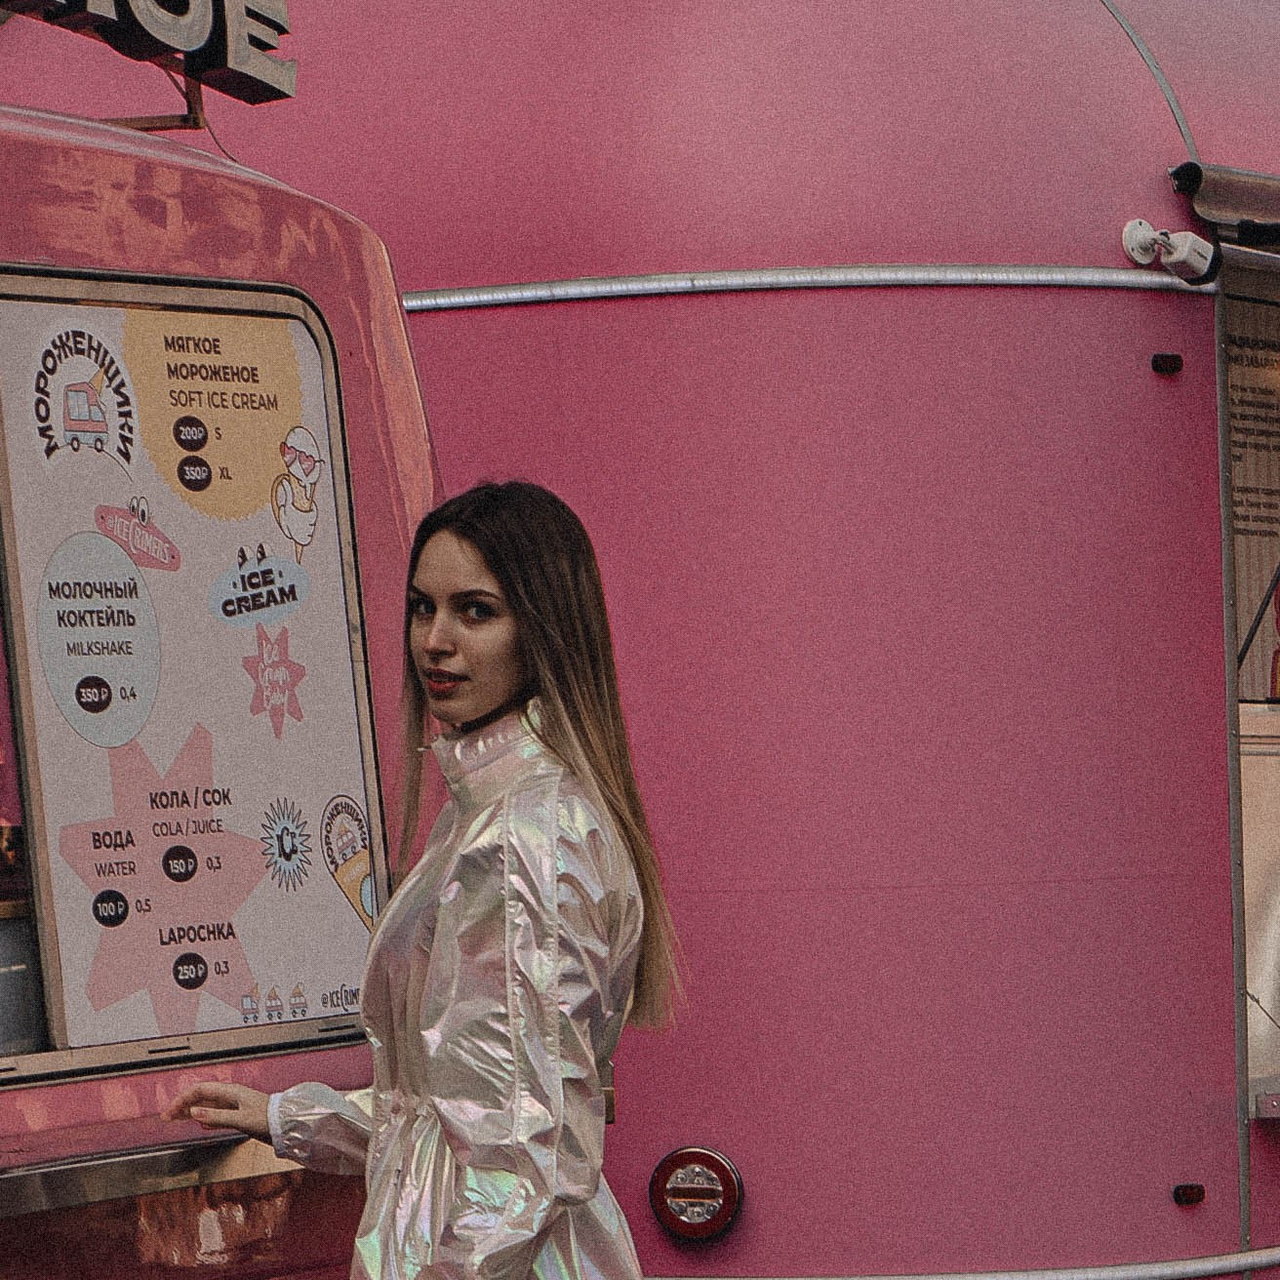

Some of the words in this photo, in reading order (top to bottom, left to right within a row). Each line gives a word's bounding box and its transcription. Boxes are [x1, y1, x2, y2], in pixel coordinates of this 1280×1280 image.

[164, 335, 221, 355] МЯГКОЕ
[166, 362, 260, 384] МОРОЖЕНОЕ
[34, 330, 136, 464] МОРОЖЕНЩИКИ
[169, 389, 203, 408] SOFT
[207, 391, 229, 409] ICE
[232, 392, 279, 411] CREAM
[214, 426, 222, 440] S
[218, 466, 233, 480] XL
[47, 577, 139, 599] МОЛОЧНЫЙ
[240, 568, 276, 592] ICE
[221, 583, 299, 617] CREAM
[56, 605, 136, 628] КОКТЕЙЛЬ
[66, 641, 134, 656] MILKSHAKE
[120, 686, 137, 702] 0,4
[149, 790, 191, 810] КОЛА
[202, 788, 233, 806] СОК
[91, 830, 136, 851] ВОДА
[95, 861, 137, 877] WATER
[206, 856, 222, 872] 0,3
[159, 922, 236, 946] LAPOCHKA
[214, 961, 230, 977] 0,3
[321, 983, 360, 1012] @ICECRIM
